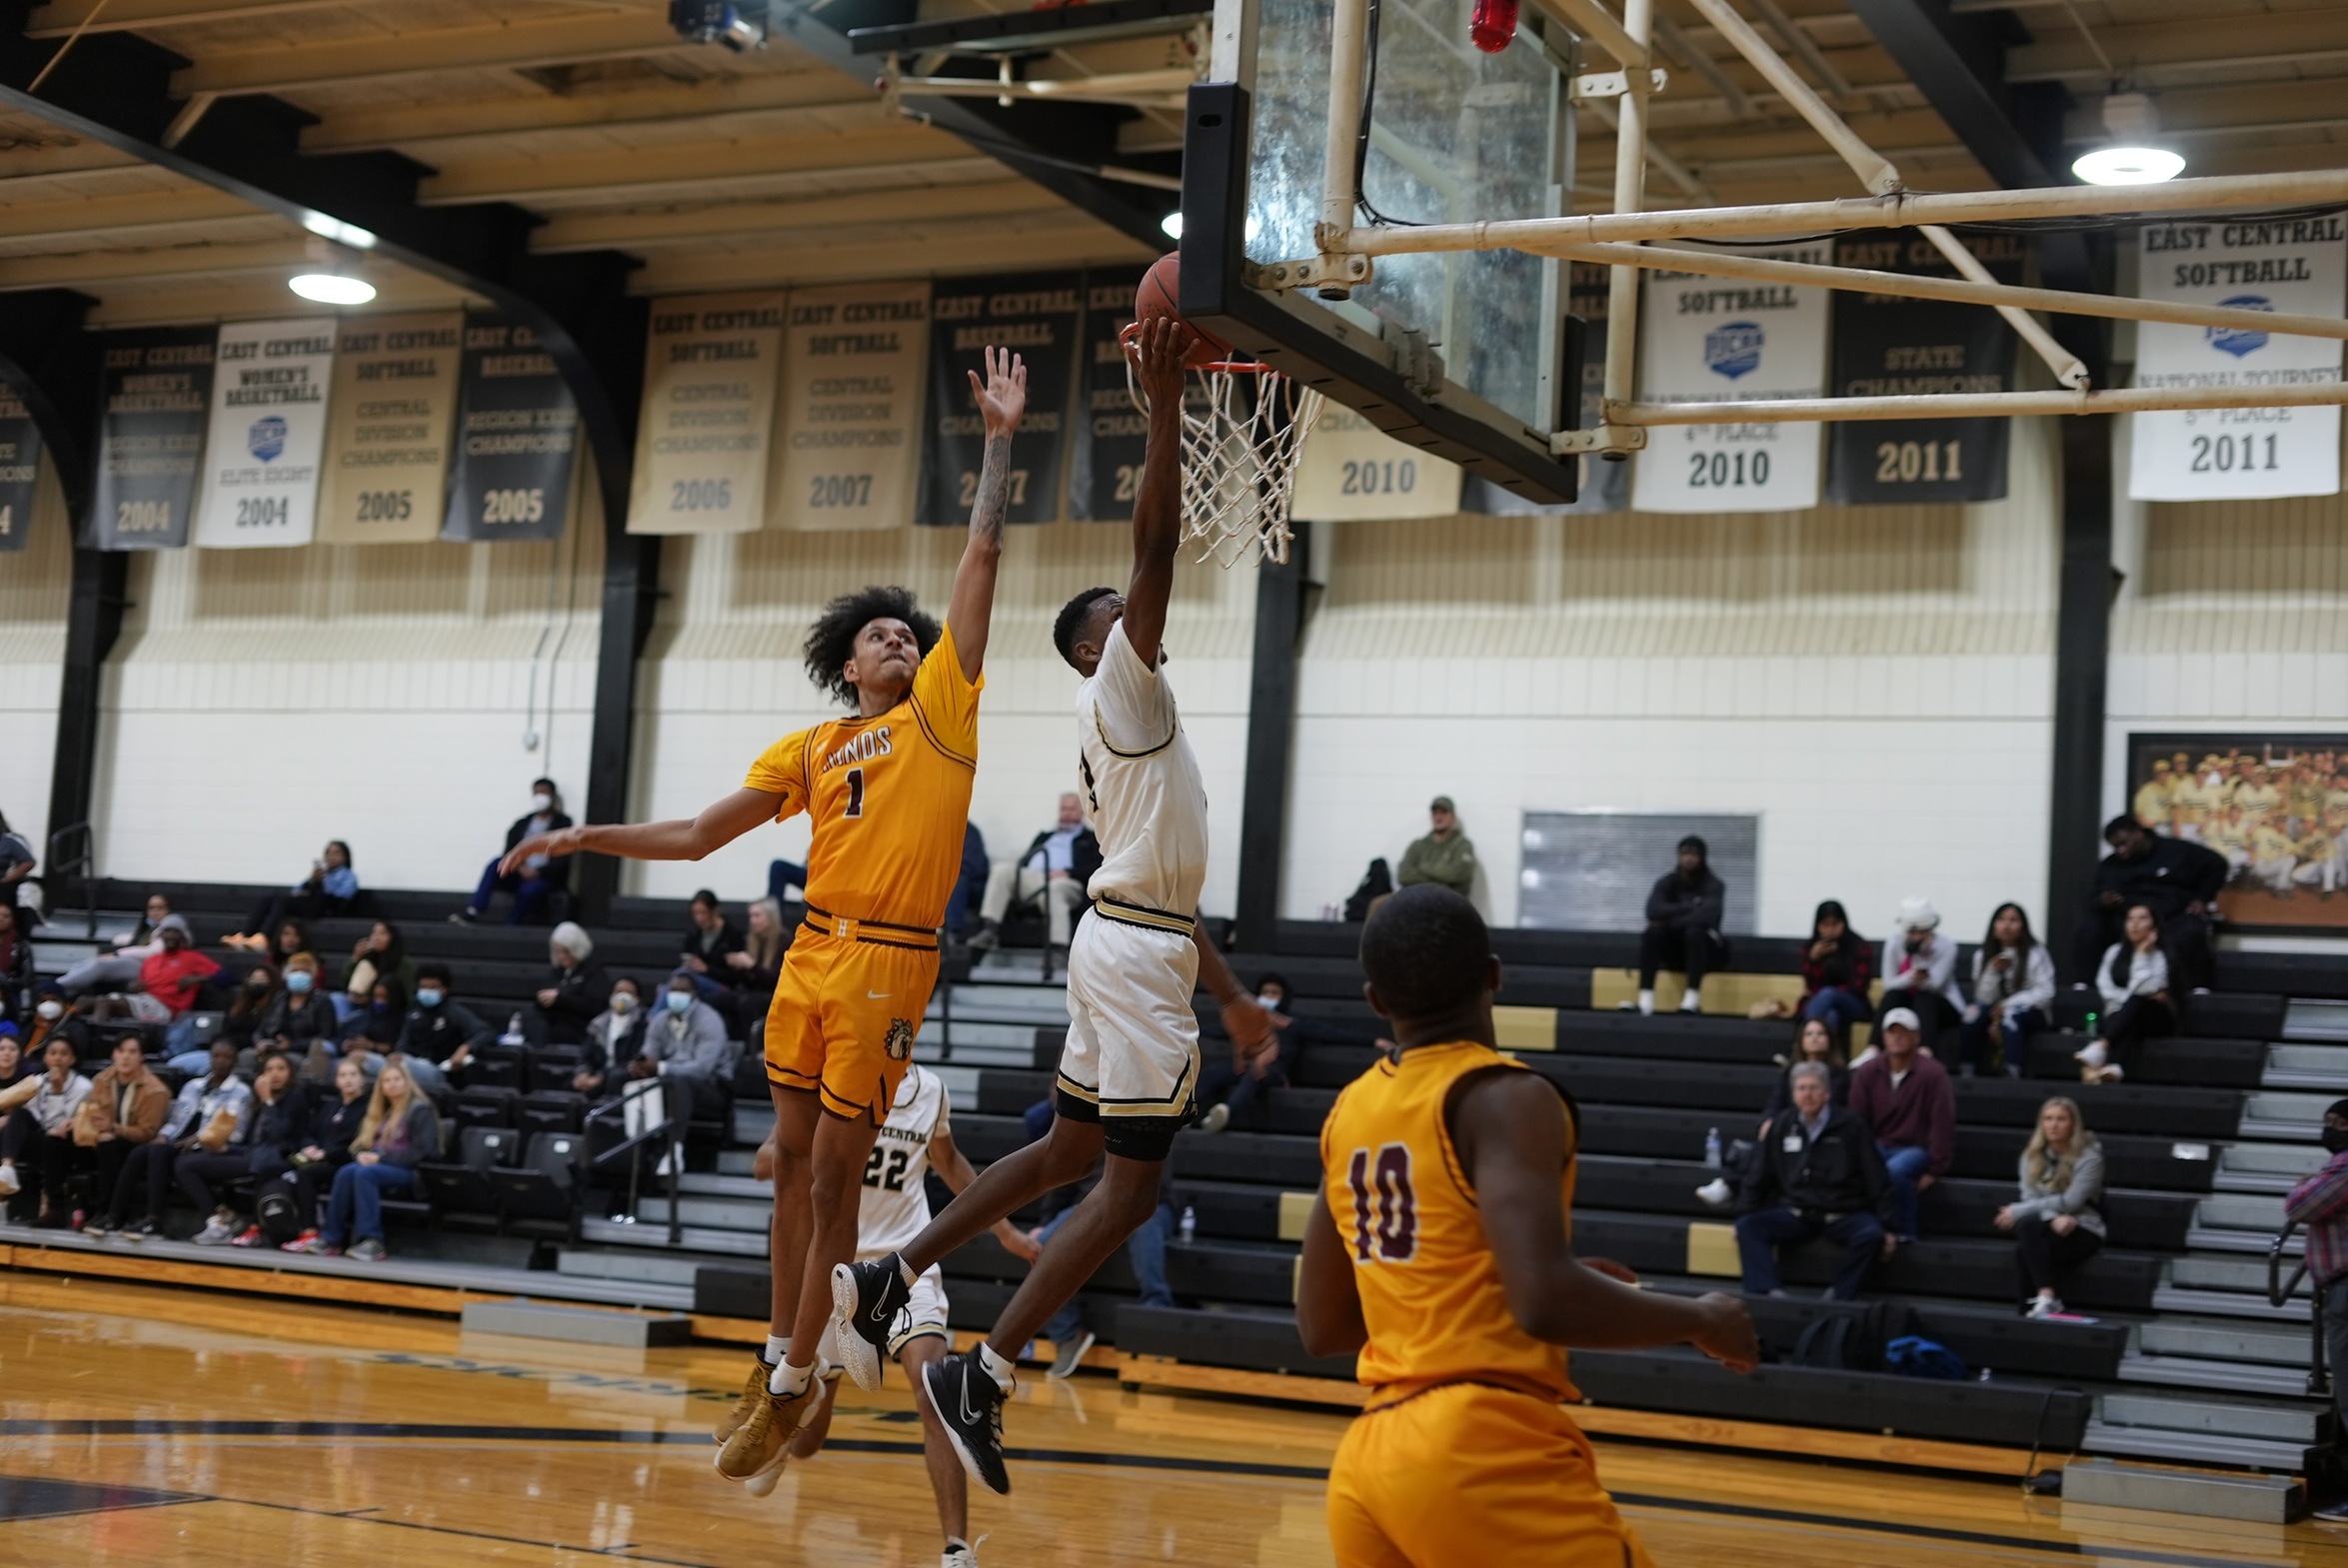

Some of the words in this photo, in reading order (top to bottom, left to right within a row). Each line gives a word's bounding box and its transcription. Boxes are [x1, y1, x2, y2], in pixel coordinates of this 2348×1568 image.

[2148, 224, 2212, 252] EAST
[2221, 217, 2345, 248] CENTRAL
[1836, 242, 1900, 267] EAST
[2174, 257, 2311, 288] SOFTBALL
[791, 305, 834, 327] EAST
[842, 300, 924, 324] CENTRAL
[934, 297, 984, 319] EAST
[990, 291, 1076, 317] CENTRAL
[1677, 284, 1798, 316] SOFTBALL
[653, 313, 697, 336] EAST
[702, 307, 783, 332] CENTRAL
[955, 322, 1054, 350] BASEBALL
[221, 341, 259, 361] EAST
[264, 335, 332, 357] CENTRAL
[341, 333, 380, 354] EAST
[386, 327, 460, 350] CENTRAL
[466, 327, 508, 350] EAST
[670, 338, 759, 363] SOFTBALL
[809, 331, 902, 356] SOFTBALL
[356, 358, 437, 381] SOFTBALL
[1885, 345, 1966, 370] STATE
[239, 366, 309, 388] WOMEN'S
[2139, 371, 2238, 390] NATIONAL
[2244, 366, 2341, 388] TOURNEY
[226, 384, 322, 408] BASKETBALL
[2220, 407, 2293, 425] PLACE
[1876, 441, 1962, 483] 2011
[2191, 432, 2279, 473] 2011
[1340, 460, 1417, 497] 2010
[1688, 452, 1769, 488] 2010
[357, 490, 412, 523] 2005
[483, 489, 544, 523] 2005
[670, 478, 733, 511] 2006
[809, 475, 874, 508] 2007
[117, 501, 170, 532] 2004
[236, 497, 289, 528] 2004
[843, 767, 864, 818] 1
[862, 1146, 908, 1192] 22
[1346, 1141, 1420, 1266] 10
